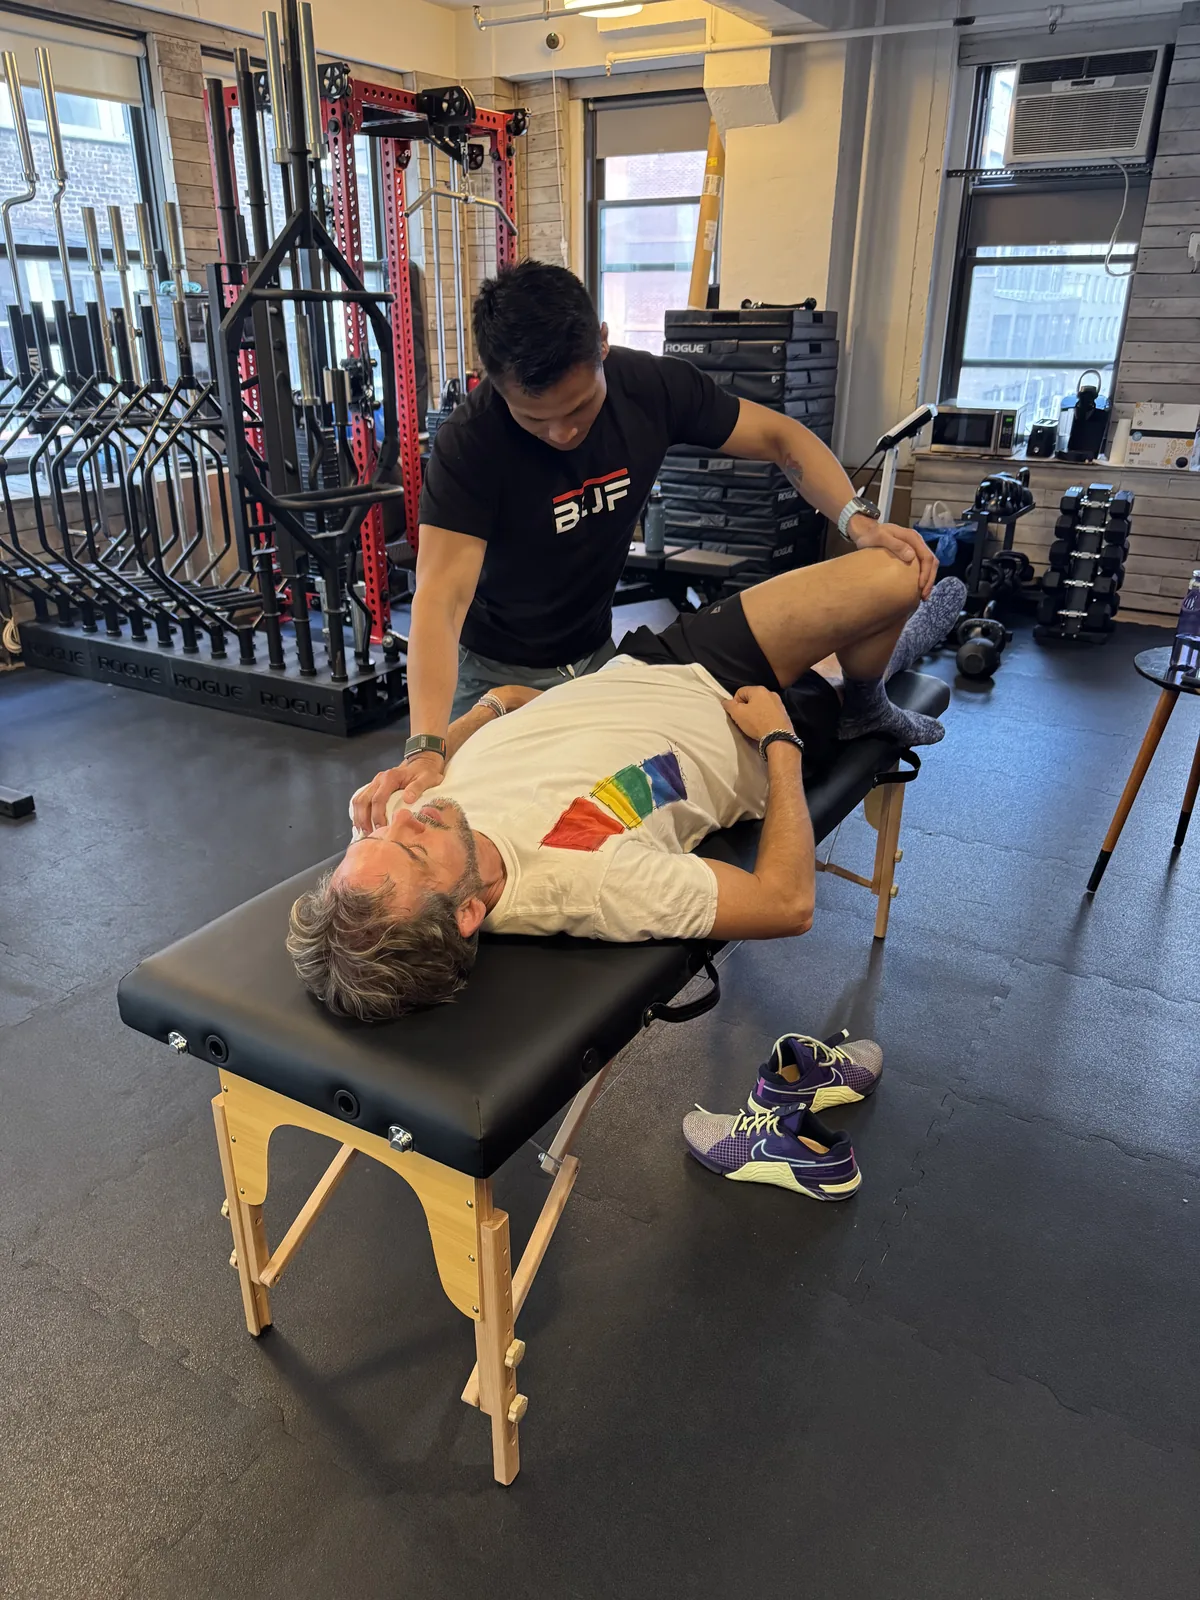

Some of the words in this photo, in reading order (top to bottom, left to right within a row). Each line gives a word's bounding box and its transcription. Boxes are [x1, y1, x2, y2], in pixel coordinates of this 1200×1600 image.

[665, 343, 704, 354] ROGUE
[98, 655, 162, 684] ROGUE
[174, 672, 243, 700] ROGUE
[260, 690, 336, 721] ROGUE
